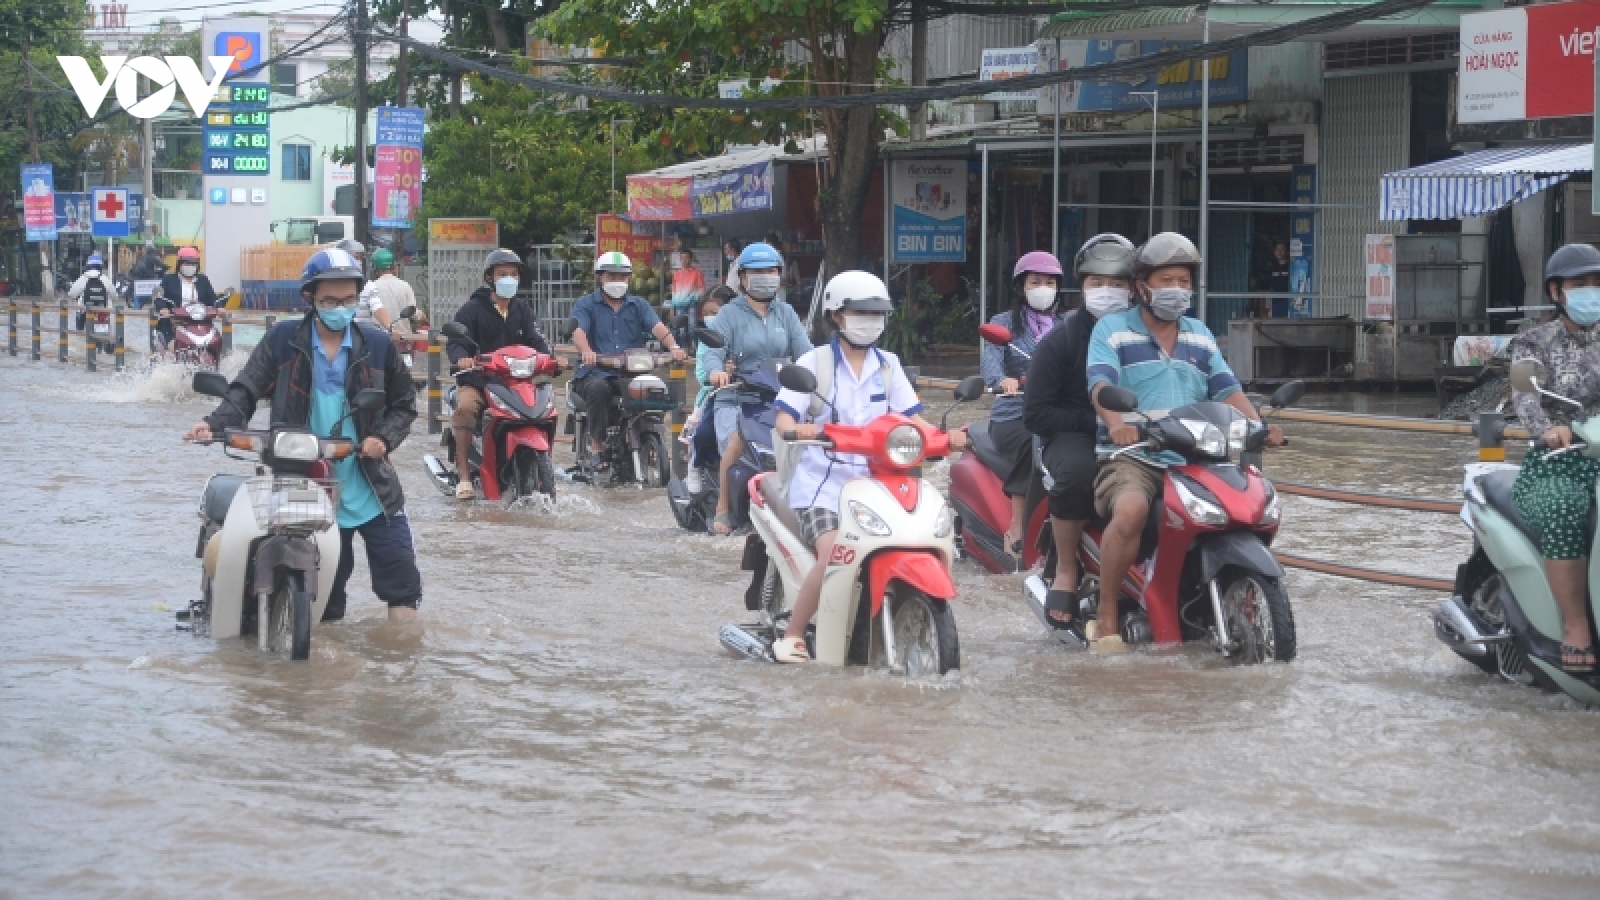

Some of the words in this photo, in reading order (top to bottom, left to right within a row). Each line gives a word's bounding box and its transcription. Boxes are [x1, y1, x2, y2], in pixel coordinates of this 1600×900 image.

[1491, 50, 1519, 73] NGỌC
[897, 235, 927, 252] BIN
[933, 235, 963, 252] BIN
